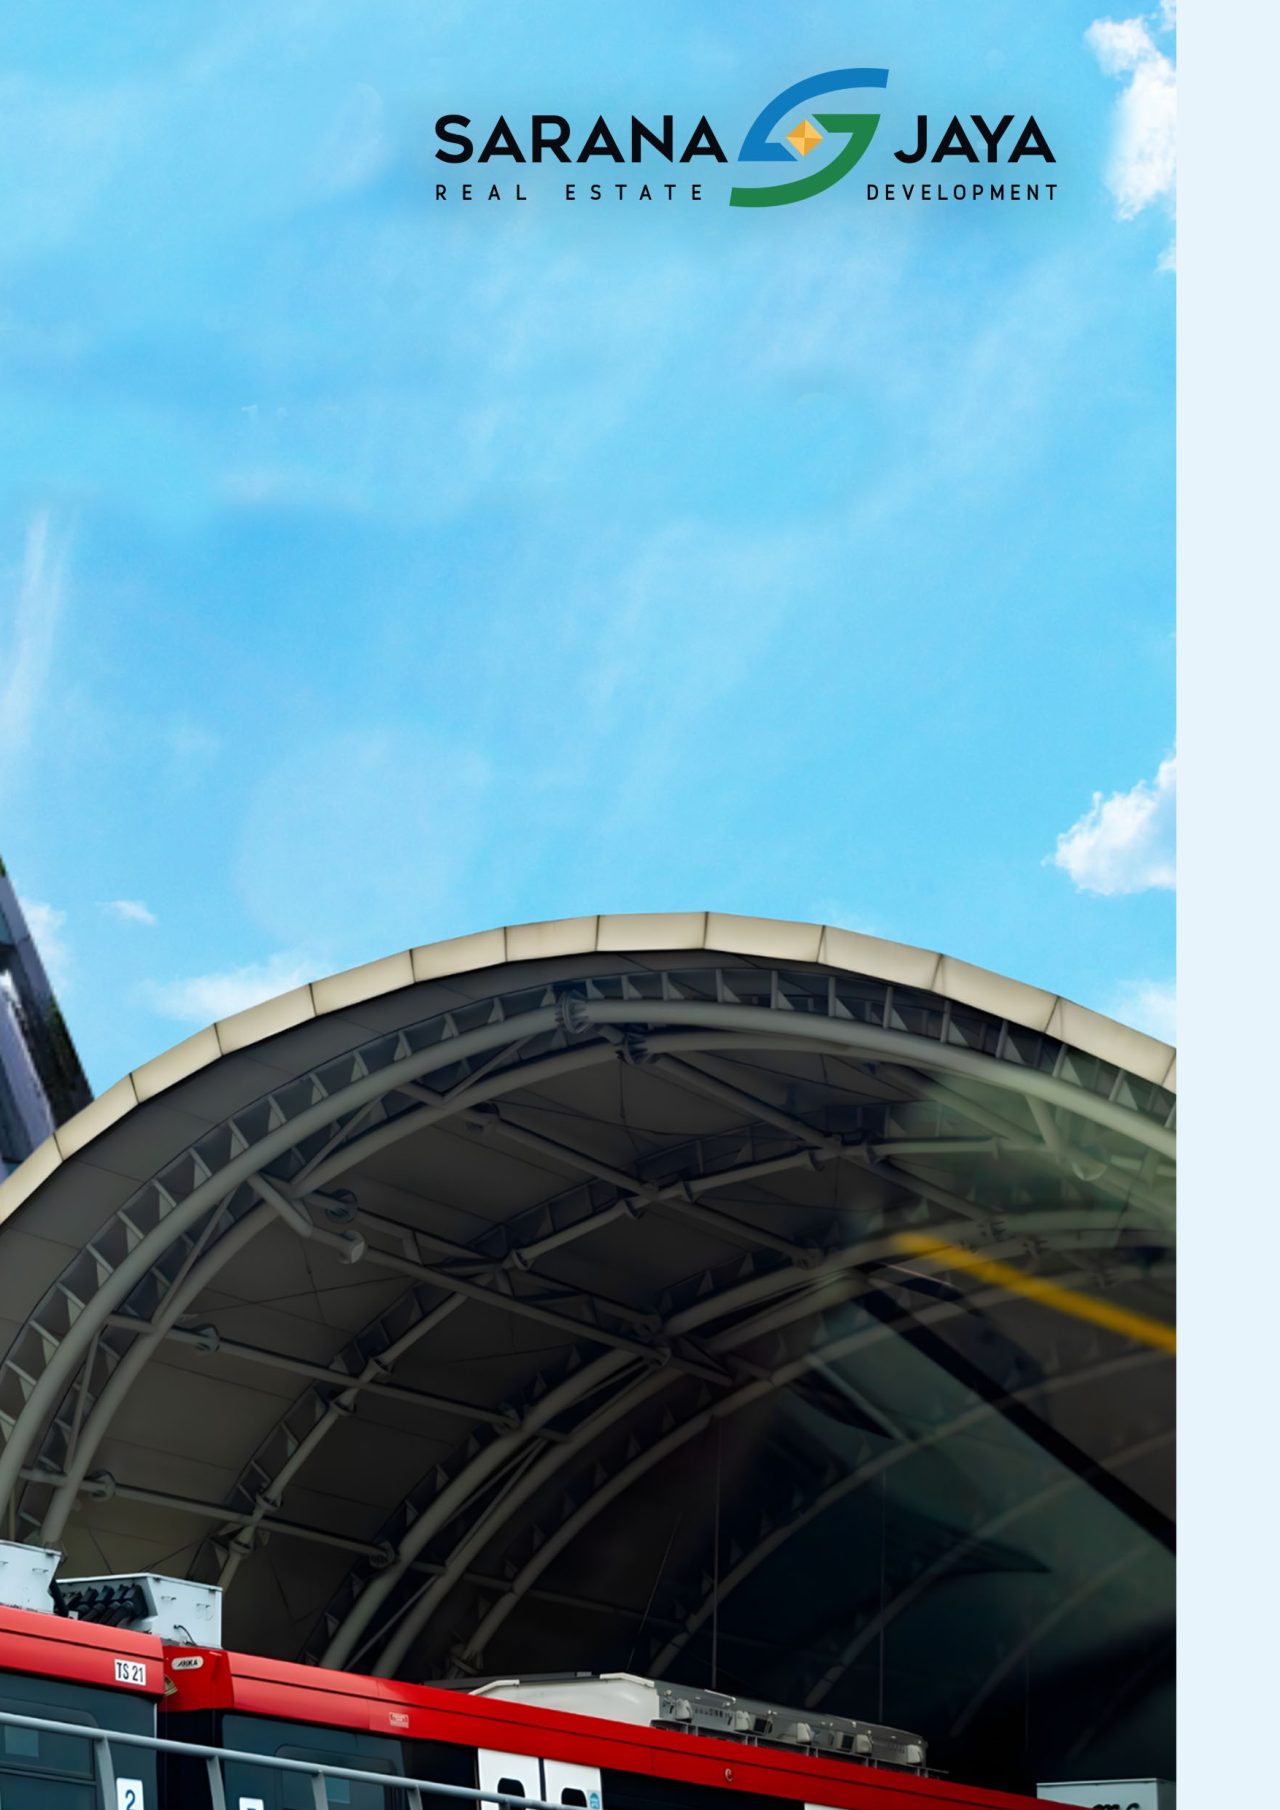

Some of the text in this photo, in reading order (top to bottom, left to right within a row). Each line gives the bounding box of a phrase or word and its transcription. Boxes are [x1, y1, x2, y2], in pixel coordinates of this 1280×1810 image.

[116, 1662, 144, 1683] TS 21
[125, 1789, 136, 1810] 2
